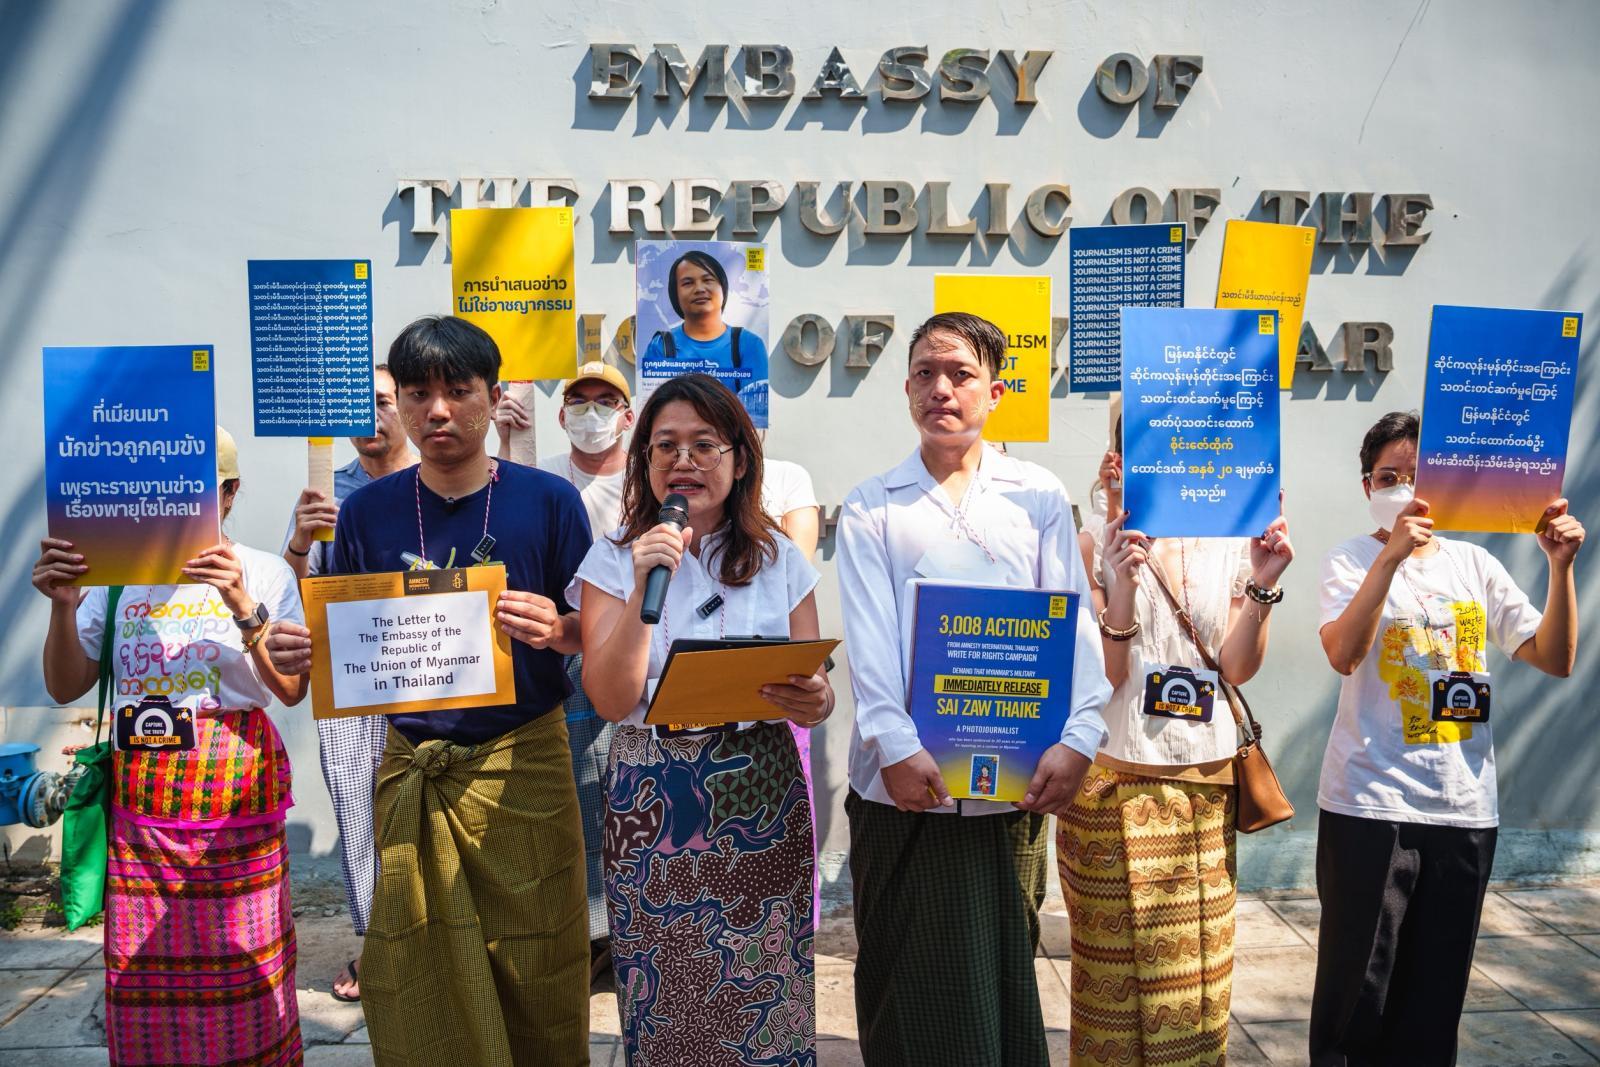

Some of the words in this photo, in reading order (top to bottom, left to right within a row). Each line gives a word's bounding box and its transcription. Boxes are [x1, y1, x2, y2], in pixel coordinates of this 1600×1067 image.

[588, 43, 1054, 105] EMBASSY
[1097, 52, 1203, 109] OF
[608, 178, 1073, 237] REPUBLIC
[1111, 187, 1222, 240] OF
[1261, 189, 1434, 246] THE
[1073, 249, 1122, 257] JOURNALISM
[1158, 246, 1181, 254] CRIME
[1073, 258, 1122, 266] JOURNALISM
[1073, 267, 1122, 275] JOURNALISM
[464, 275, 566, 292] การนำเสนอข่าว
[1073, 276, 1122, 284] JOURNALISM
[1073, 285, 1122, 293] JOURNALISM
[458, 296, 572, 314] ไม่ใช่อาชญากรรม
[1073, 294, 1122, 302] JOURNALISM
[1073, 303, 1122, 311] JOURNALISM
[783, 313, 895, 368] OF
[93, 399, 168, 423] ที่เมียนมา
[59, 434, 205, 463] นักข่าวถูกคุมขัง
[61, 475, 204, 497] เพราะรายงานข่าว
[65, 496, 200, 522] เรื่องพายุไซโคลน
[372, 617, 394, 627] The
[397, 615, 430, 626] Letter
[435, 613, 446, 623] to
[939, 615, 981, 637] 3,008
[985, 617, 1050, 638] ACTIONS
[359, 633, 378, 643] The
[382, 630, 427, 642] Embassy
[431, 627, 442, 637] of
[445, 627, 461, 636] the
[381, 644, 428, 656] Republic
[431, 642, 441, 651] of
[948, 650, 967, 658] WRITE
[969, 651, 980, 659] FOR
[982, 652, 1003, 660] RIGHTS
[1005, 653, 1037, 662] CAMPAIGN
[344, 663, 366, 674] The
[371, 661, 406, 672] Union
[410, 658, 422, 669] of
[426, 654, 481, 669] Myanmar
[374, 678, 388, 690] in
[392, 672, 454, 689] Thailand
[943, 679, 1002, 692] IMMEDIATELY
[1004, 682, 1042, 694] RELEASE
[937, 698, 958, 715] SAI
[962, 699, 992, 717] ZAW
[995, 701, 1040, 718] THAIKE
[962, 725, 1019, 734] PHOTOJOURNALIST
